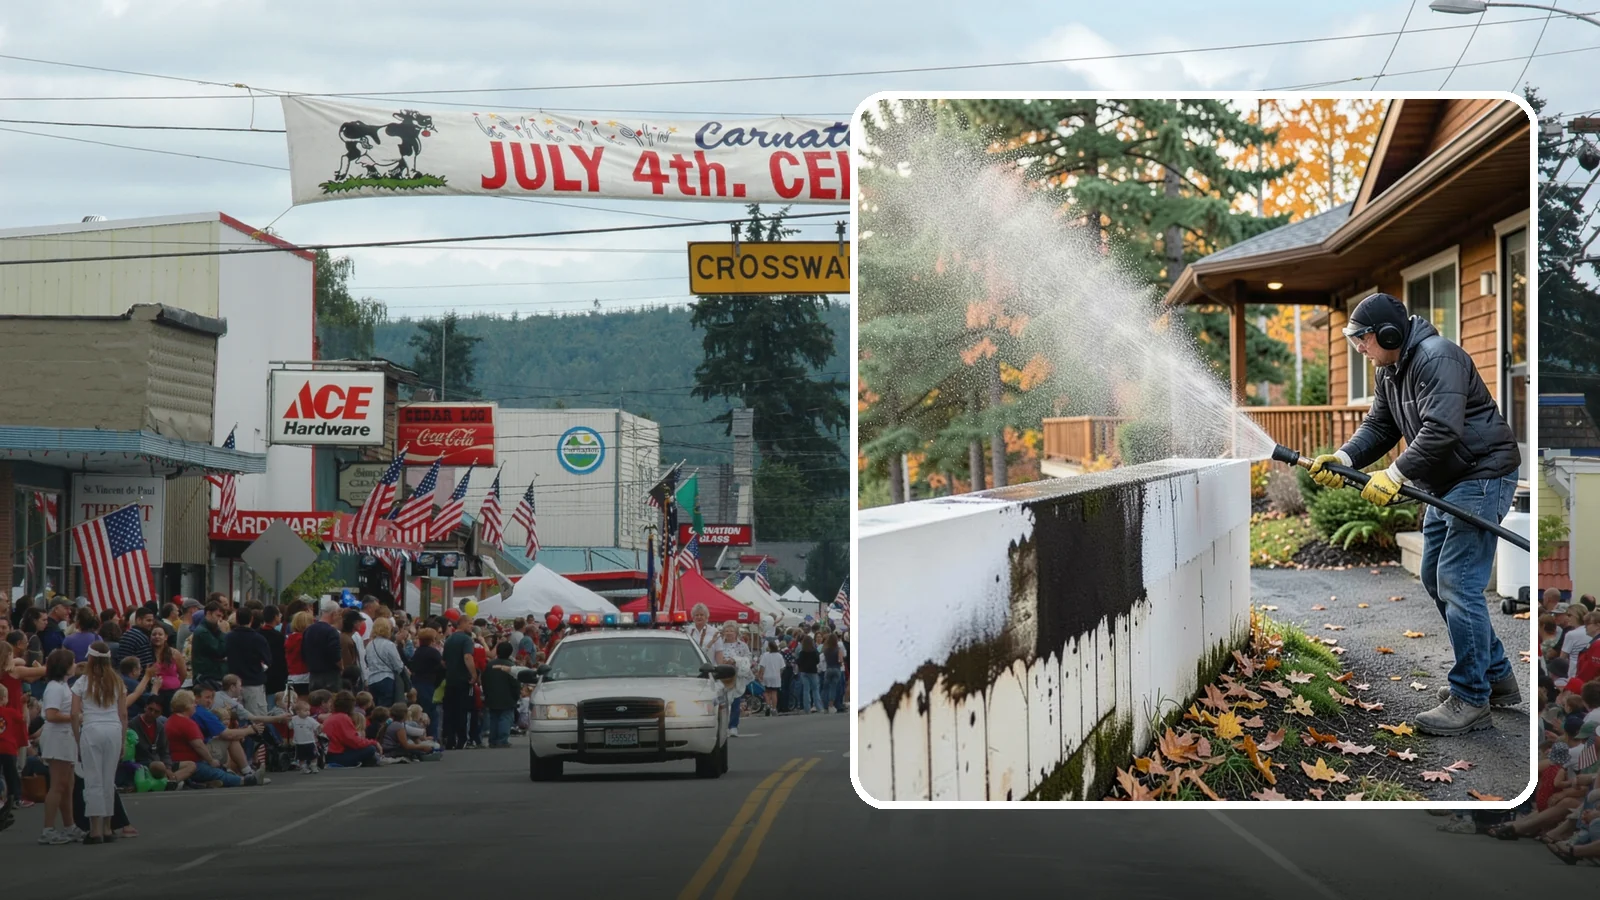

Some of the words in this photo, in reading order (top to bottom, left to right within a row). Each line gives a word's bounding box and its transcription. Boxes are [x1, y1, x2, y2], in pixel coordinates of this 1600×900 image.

[481, 141, 604, 192] JULY
[632, 150, 746, 197] 4th.
[697, 254, 850, 280] CROSSWA
[283, 380, 373, 419] ACE
[283, 421, 370, 435] Hardware
[416, 428, 477, 446] Coca-Cola
[353, 467, 384, 480] Simpl
[83, 485, 94, 494] St.
[95, 485, 124, 494] Vincent
[126, 485, 135, 494] de
[138, 486, 155, 494] Paul
[81, 503, 153, 521] THT
[688, 526, 741, 534] CRNATION
[699, 535, 730, 543] GLASS
